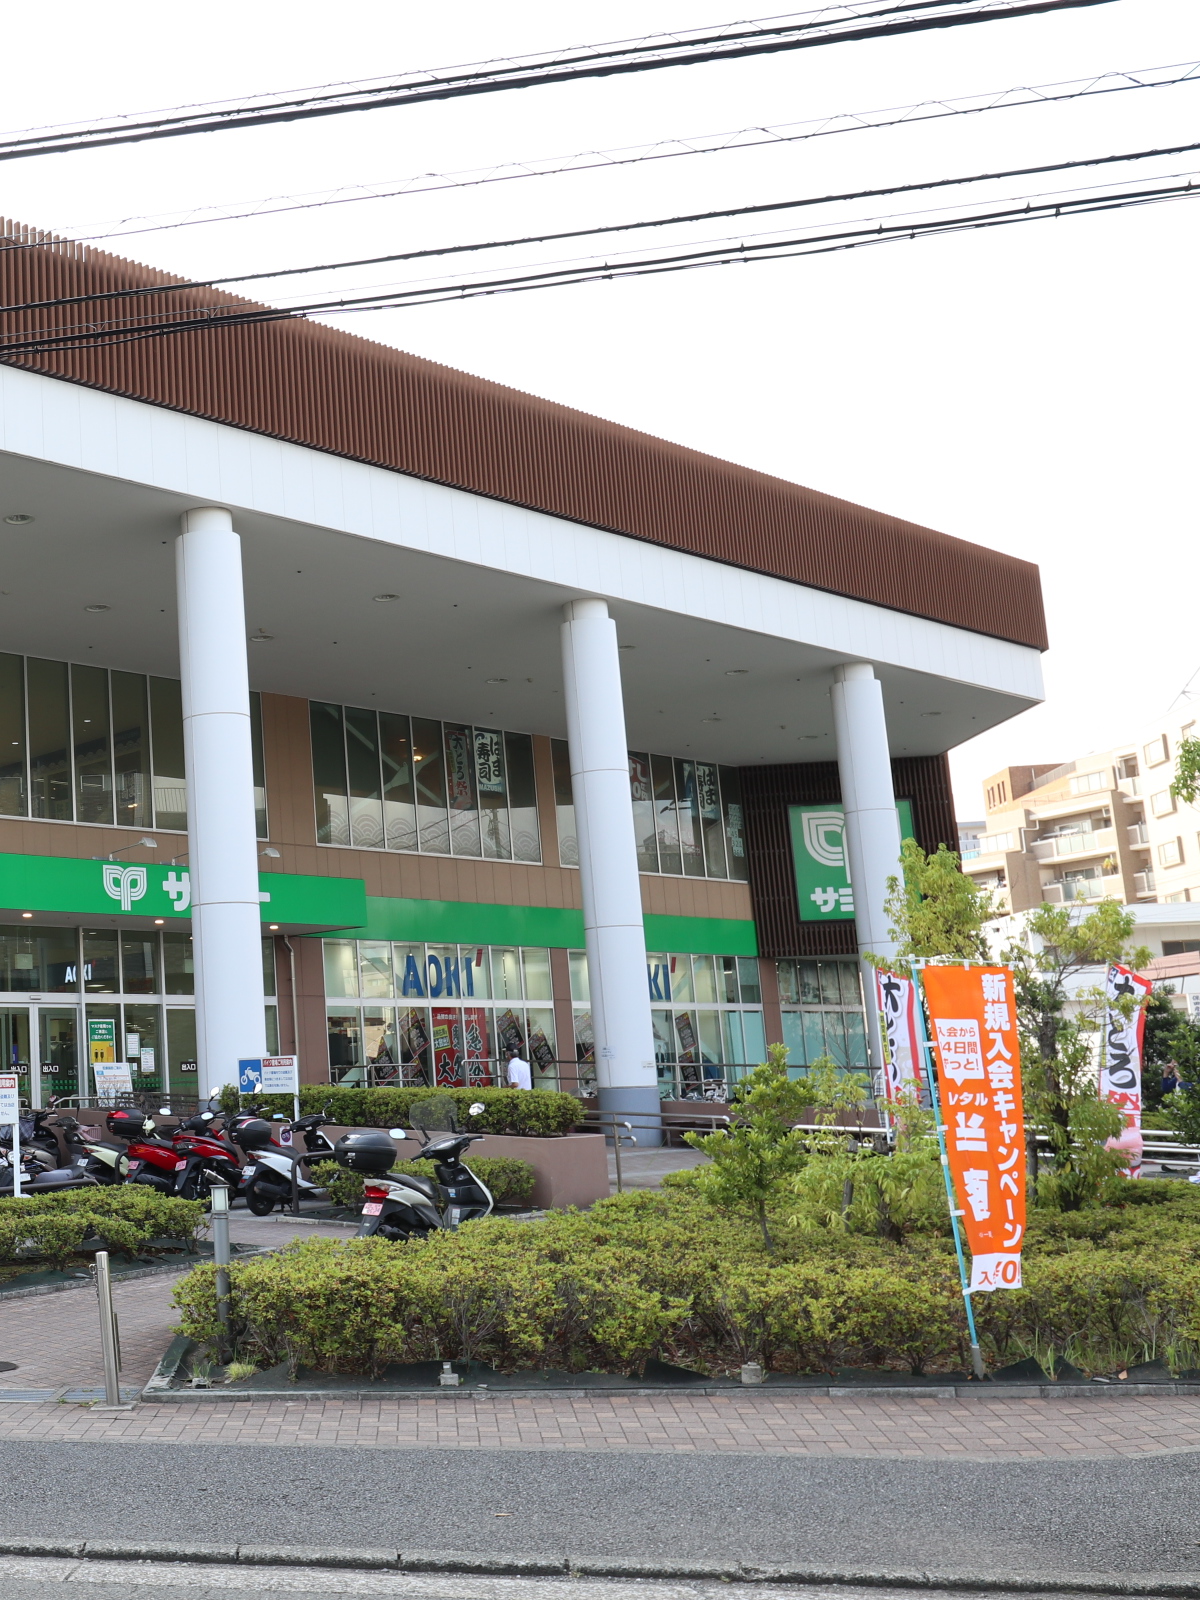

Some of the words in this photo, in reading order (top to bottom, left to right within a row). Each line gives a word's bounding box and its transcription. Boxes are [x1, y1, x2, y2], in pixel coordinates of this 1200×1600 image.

[477, 742, 492, 783] 寿司
[937, 1026, 976, 1038] 入会から
[939, 1041, 979, 1055] 4日間
[42, 1065, 59, 1073] 出入口
[181, 1063, 196, 1071] 出入口
[981, 973, 1022, 1248] 新規入会キャンペーン
